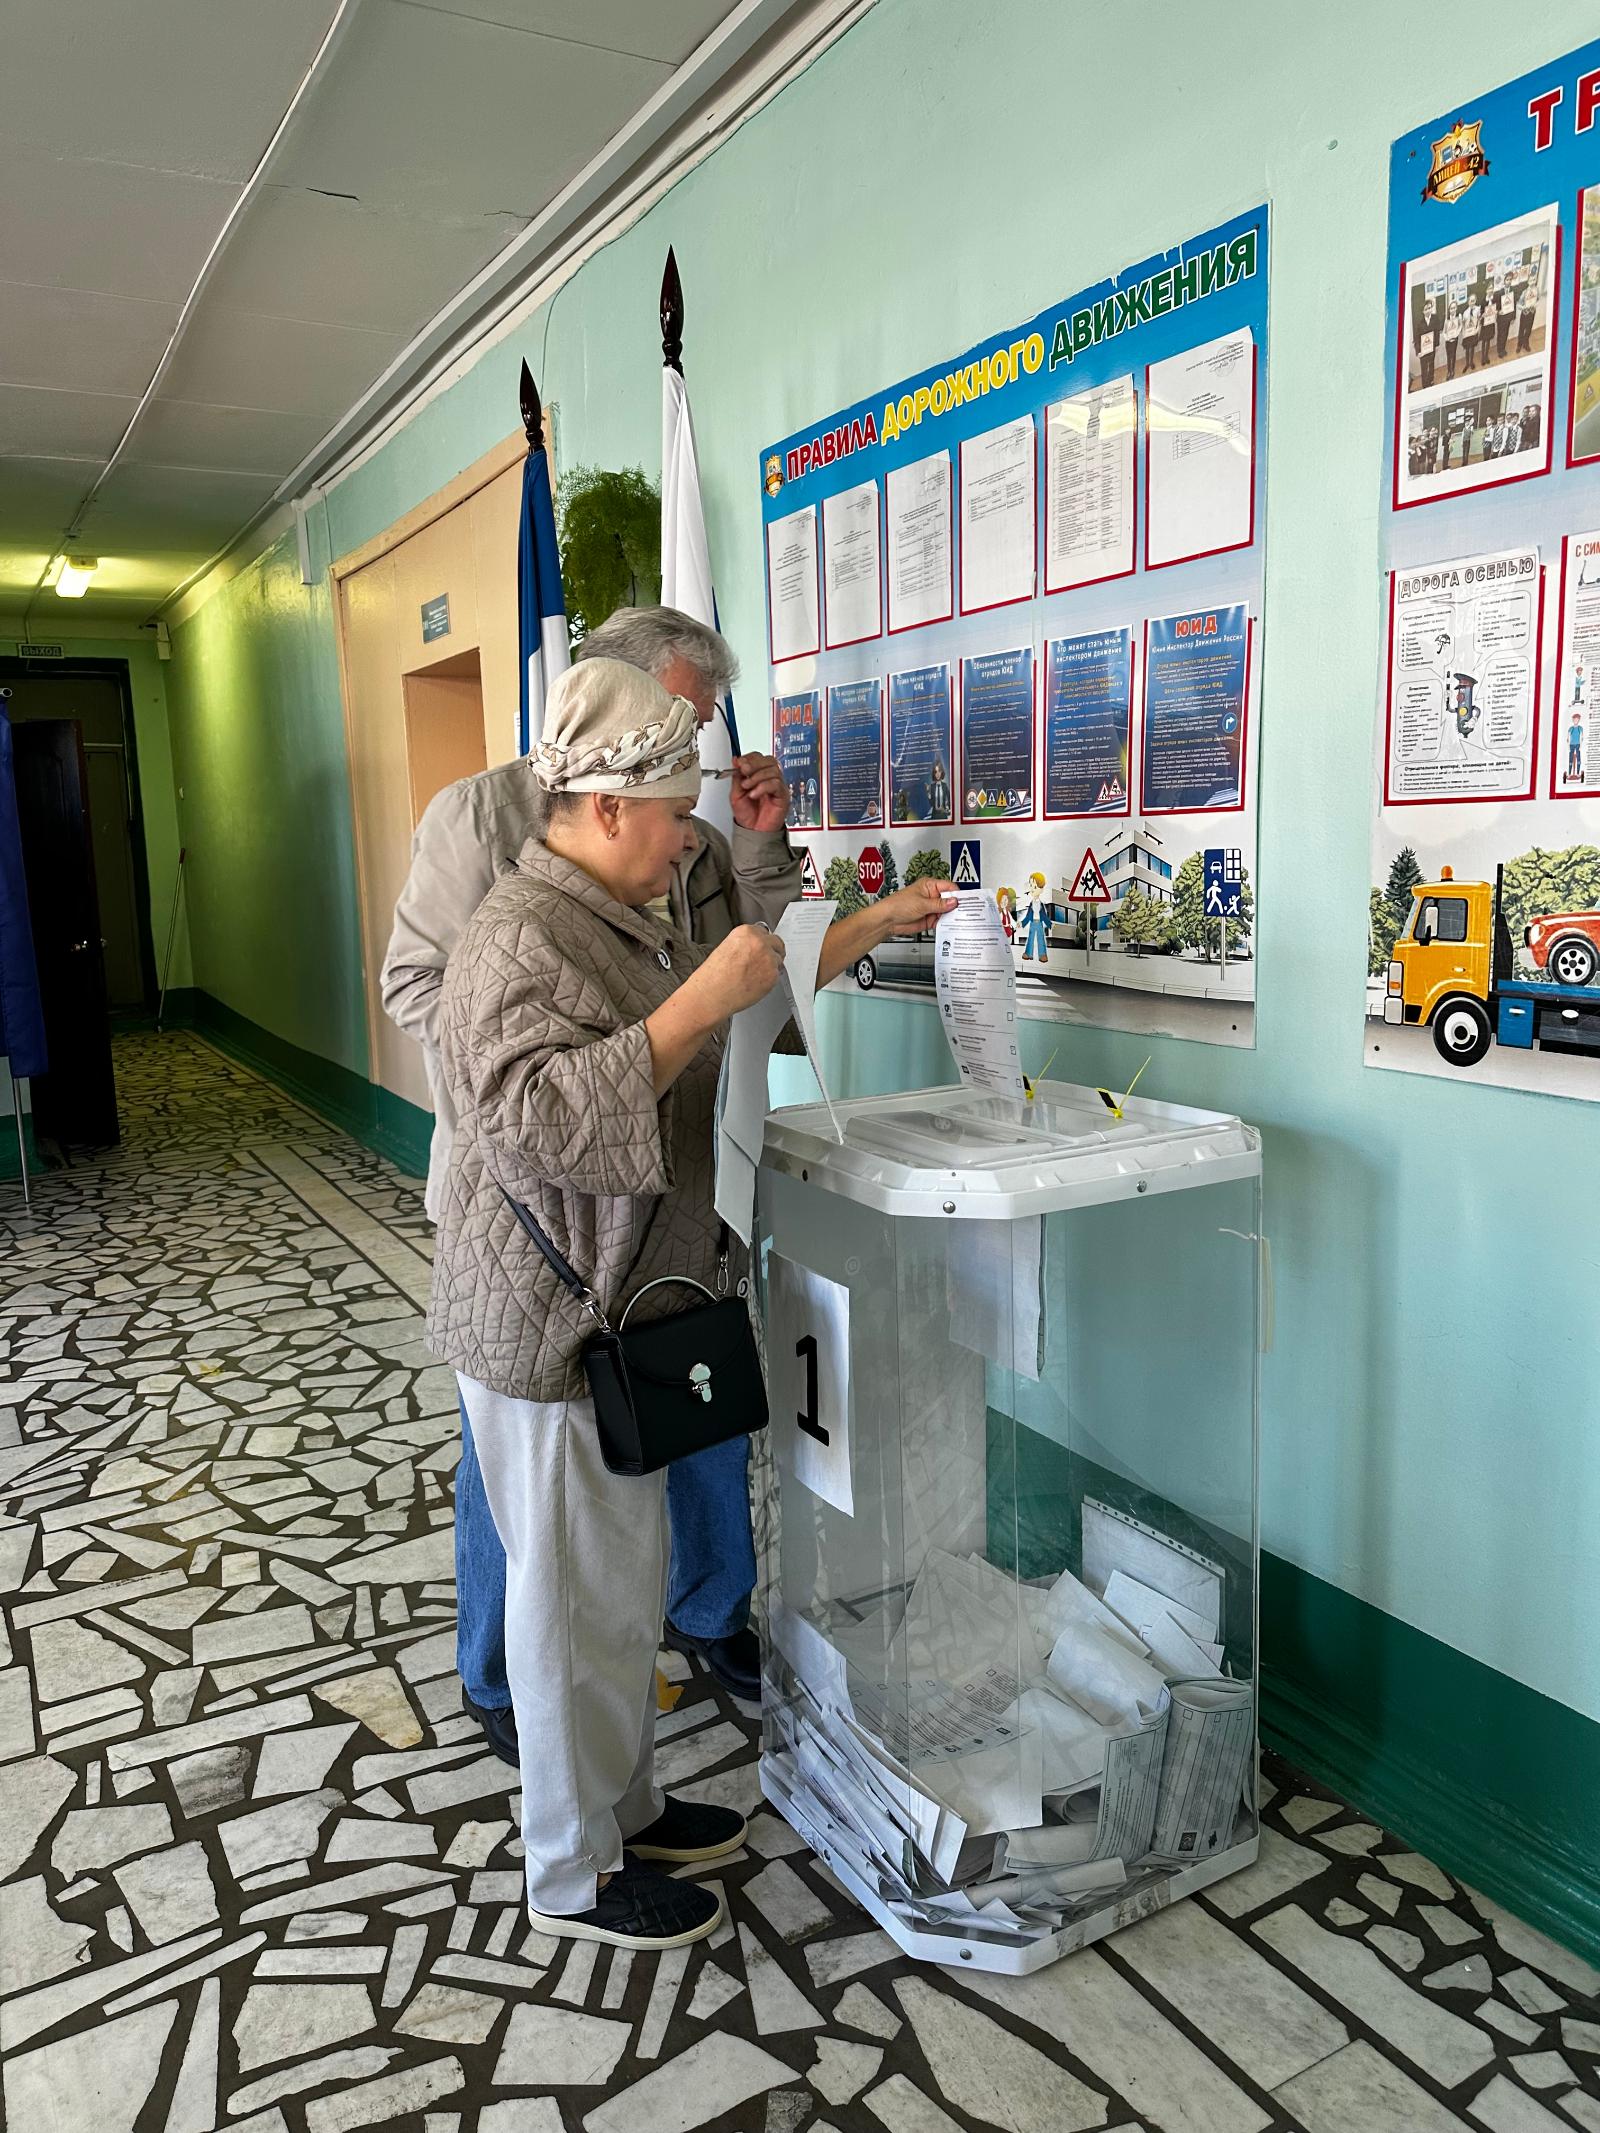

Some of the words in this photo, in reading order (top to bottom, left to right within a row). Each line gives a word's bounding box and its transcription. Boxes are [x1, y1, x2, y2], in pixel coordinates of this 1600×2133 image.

[787, 412, 878, 483] ПРАВИЛА
[881, 332, 1045, 447] ДОРОЖНОГО
[1049, 229, 1257, 372] ДВИЖЕНИЯ
[1400, 571, 1460, 599] ДОРОГА
[1464, 557, 1534, 584] ОСЕНЬЮ
[1175, 614, 1218, 639] ЮИД
[22, 646, 61, 656] ВЫХОД
[780, 703, 814, 727] ЮИД
[859, 861, 883, 880] STOP
[796, 1334, 829, 1447] 1
